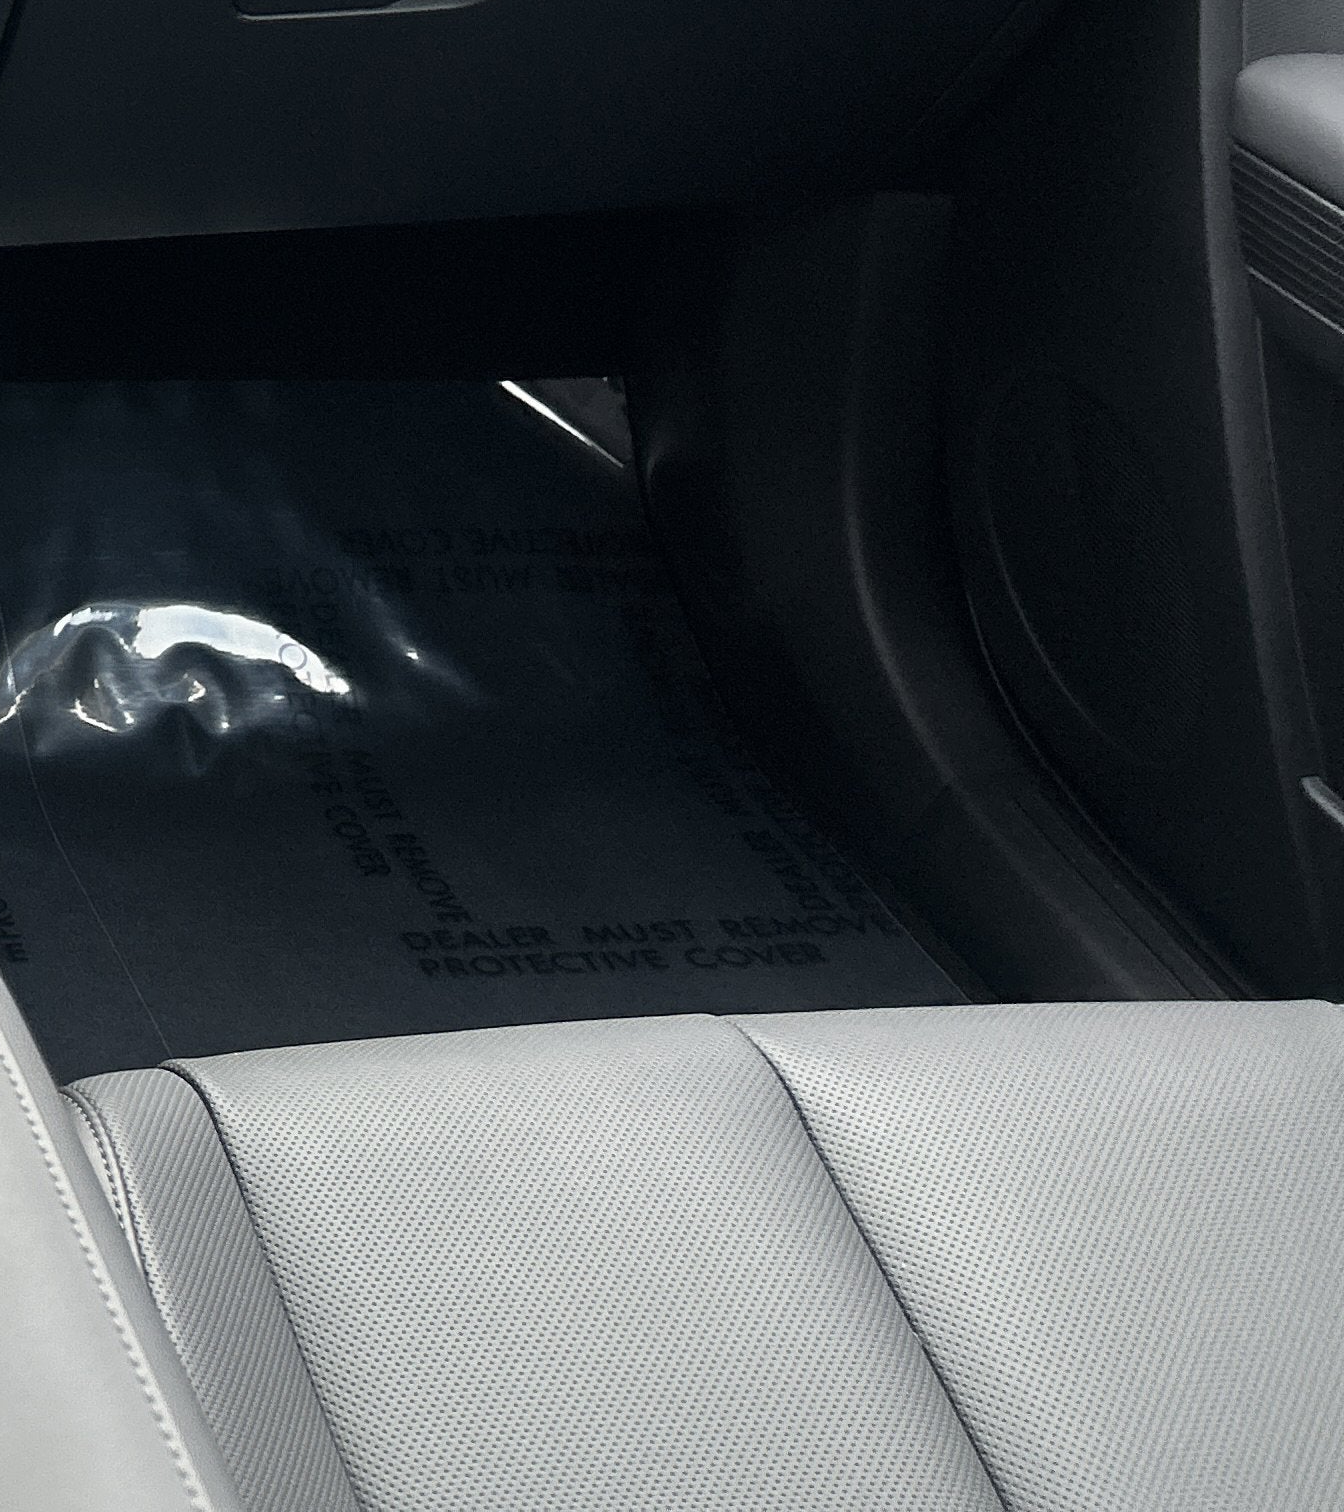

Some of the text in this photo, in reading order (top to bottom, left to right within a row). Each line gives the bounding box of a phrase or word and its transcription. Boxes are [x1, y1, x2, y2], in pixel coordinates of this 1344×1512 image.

[399, 924, 555, 952] DEALER
[582, 918, 697, 944] MUST
[418, 941, 830, 980] PROTECTIVE COVER
